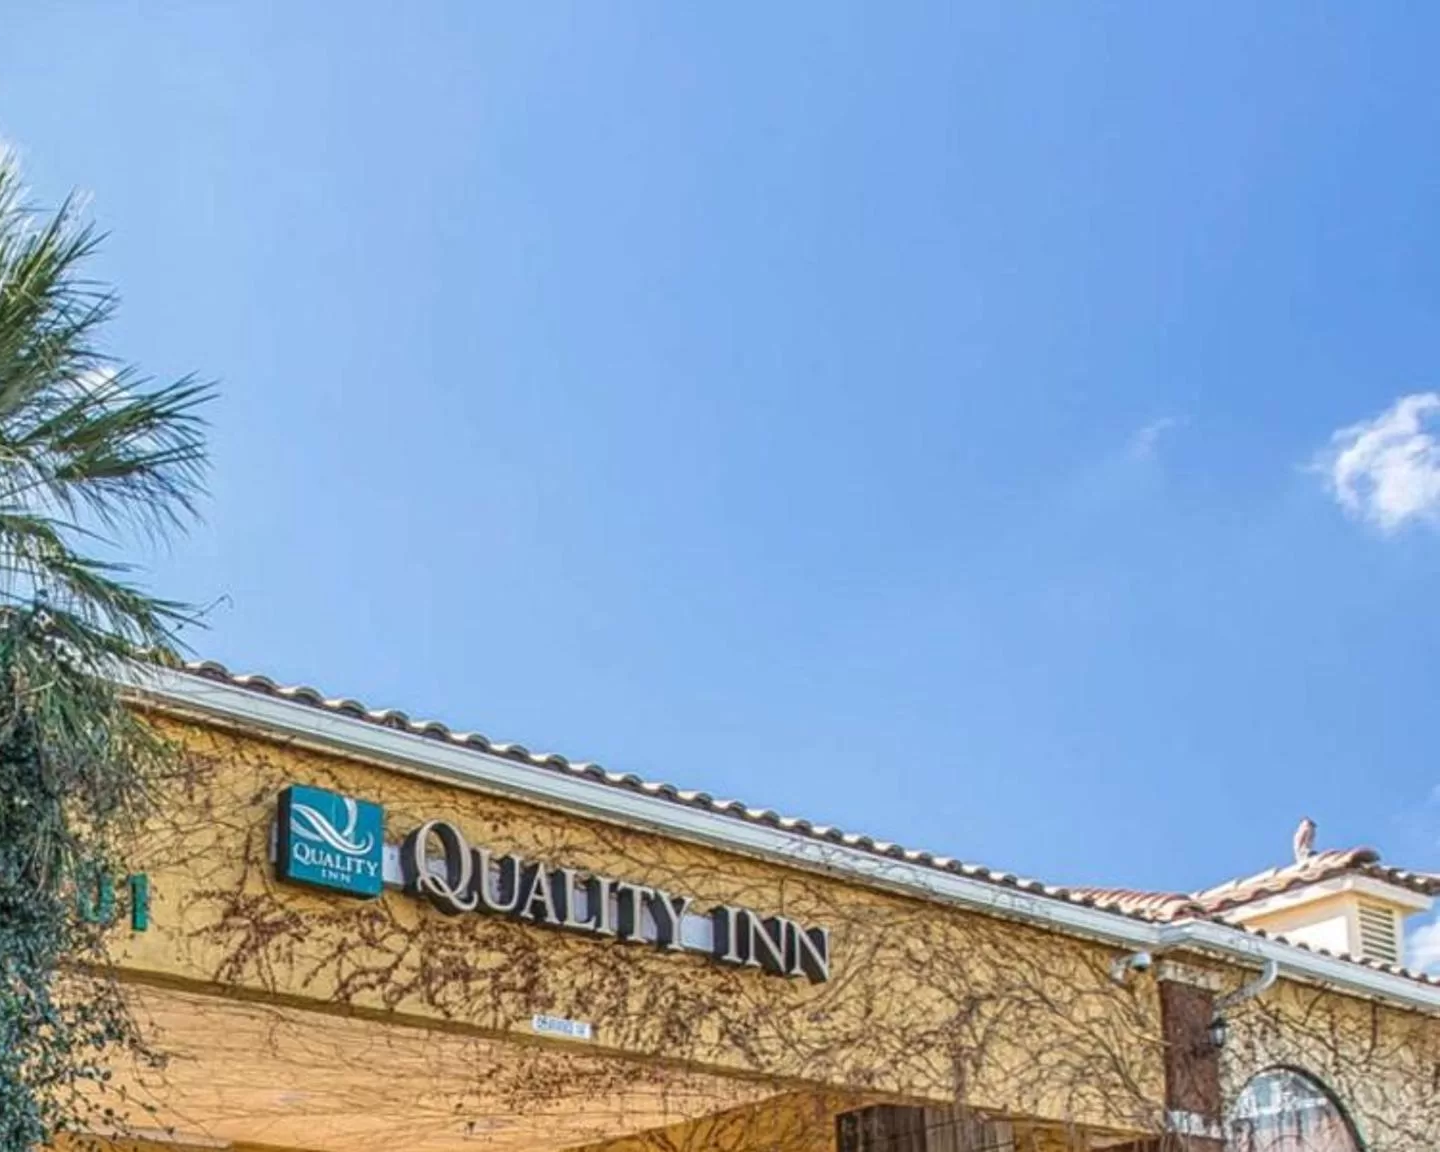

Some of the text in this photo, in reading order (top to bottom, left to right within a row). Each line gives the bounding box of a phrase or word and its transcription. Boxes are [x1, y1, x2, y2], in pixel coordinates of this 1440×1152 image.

[292, 842, 379, 877] QUALITY
[321, 869, 352, 884] INN
[414, 819, 831, 981] QUALITY INN
